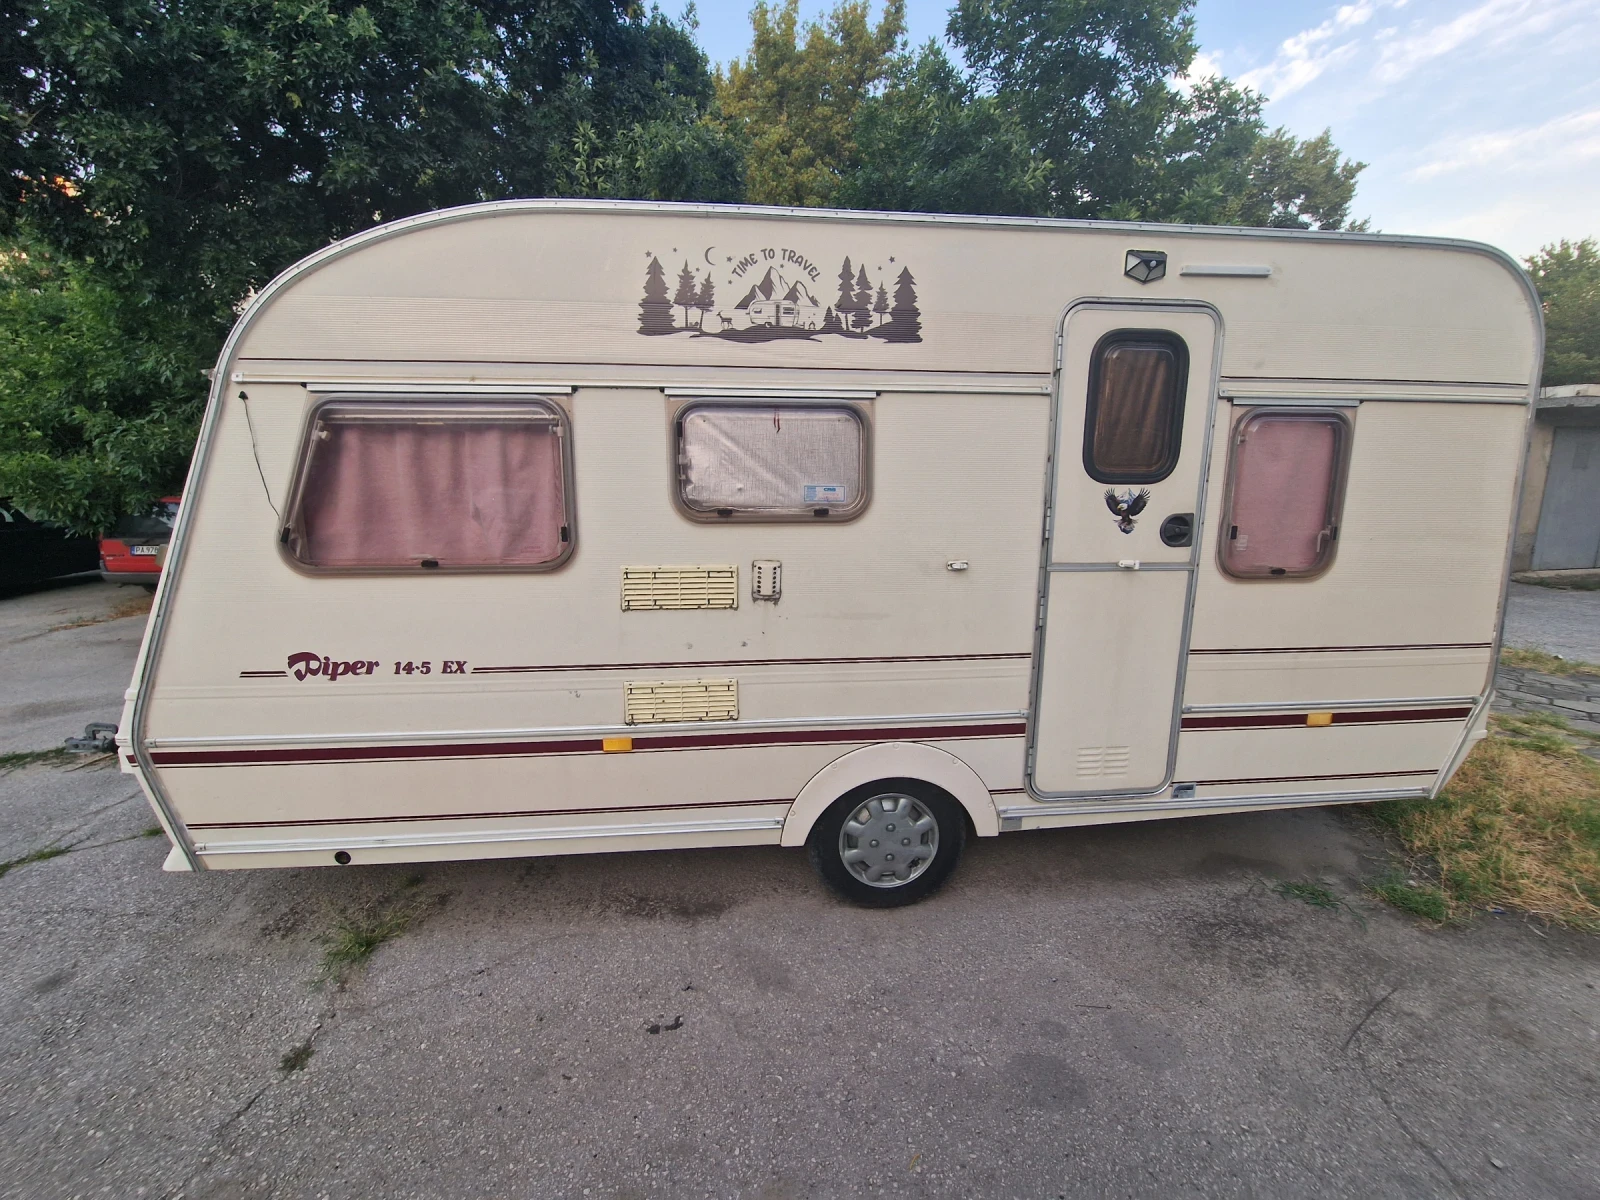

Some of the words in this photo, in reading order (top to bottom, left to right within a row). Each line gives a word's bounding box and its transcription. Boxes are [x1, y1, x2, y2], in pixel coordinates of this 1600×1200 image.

[731, 253, 758, 278] TIME
[760, 248, 776, 261] TO
[781, 248, 820, 282] TRAVEL
[287, 651, 380, 682] Piper
[441, 660, 468, 674] EX
